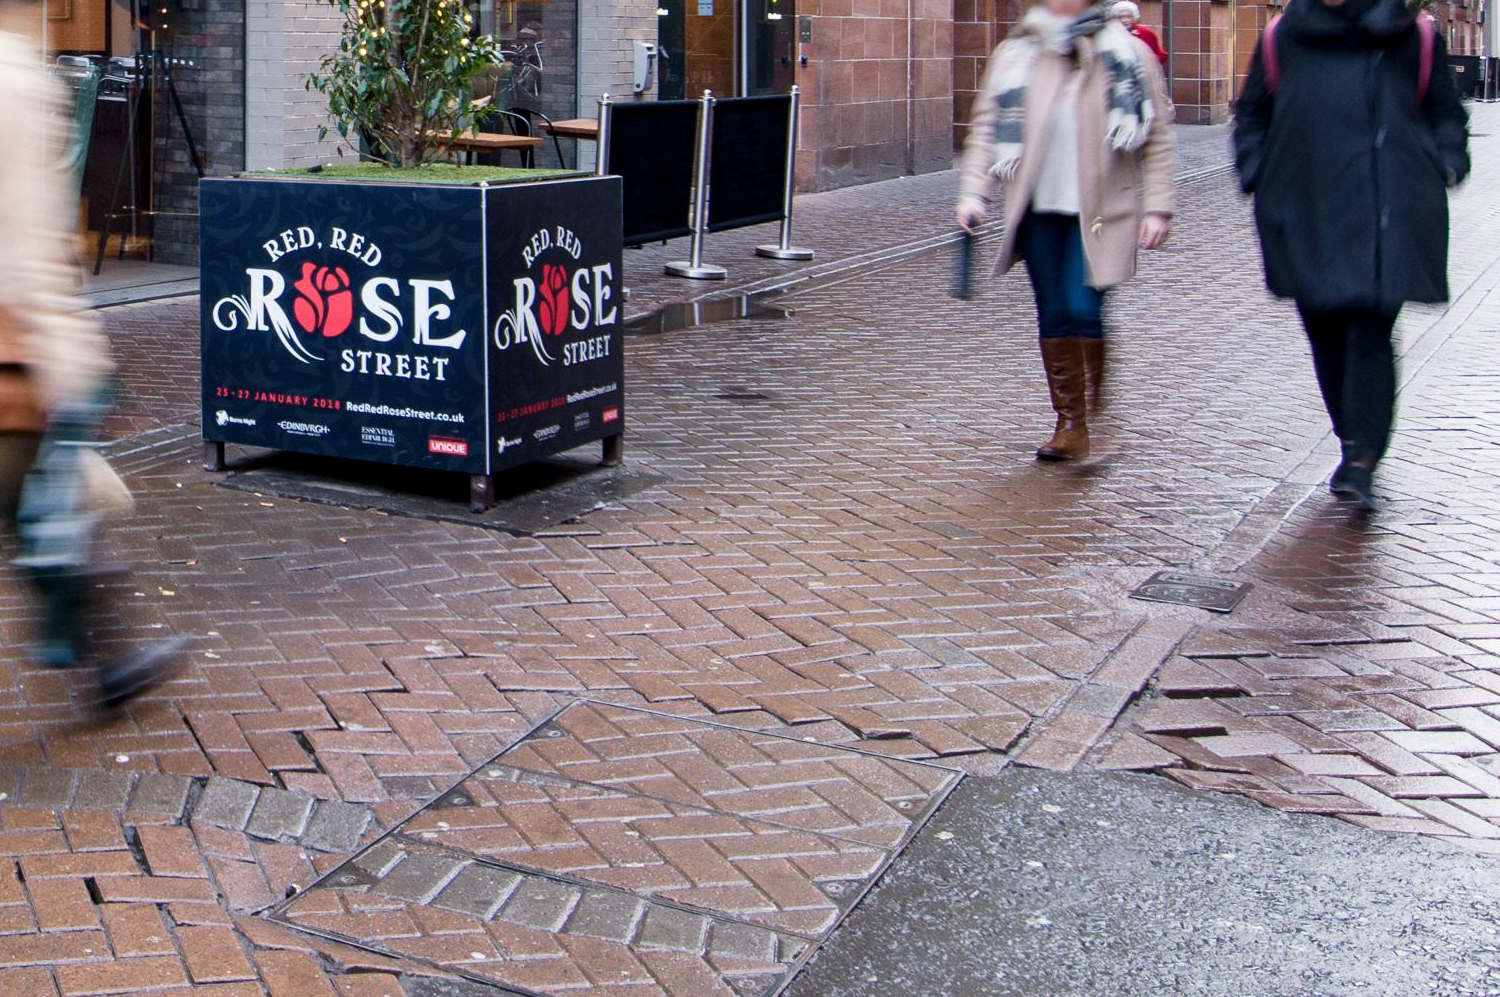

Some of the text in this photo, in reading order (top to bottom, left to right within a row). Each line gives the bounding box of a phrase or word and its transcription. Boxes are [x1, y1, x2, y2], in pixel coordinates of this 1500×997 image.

[262, 226, 382, 268] RED, RED
[556, 225, 582, 260] RED
[341, 349, 449, 381] STREET
[563, 334, 611, 366] STREET
[254, 392, 309, 406] JANUARY
[313, 398, 341, 410] 2018
[346, 401, 465, 424] RedRedRoseStreet.co.uk
[361, 426, 395, 436] ESSENTIAL
[430, 442, 466, 453] UNIQUE
